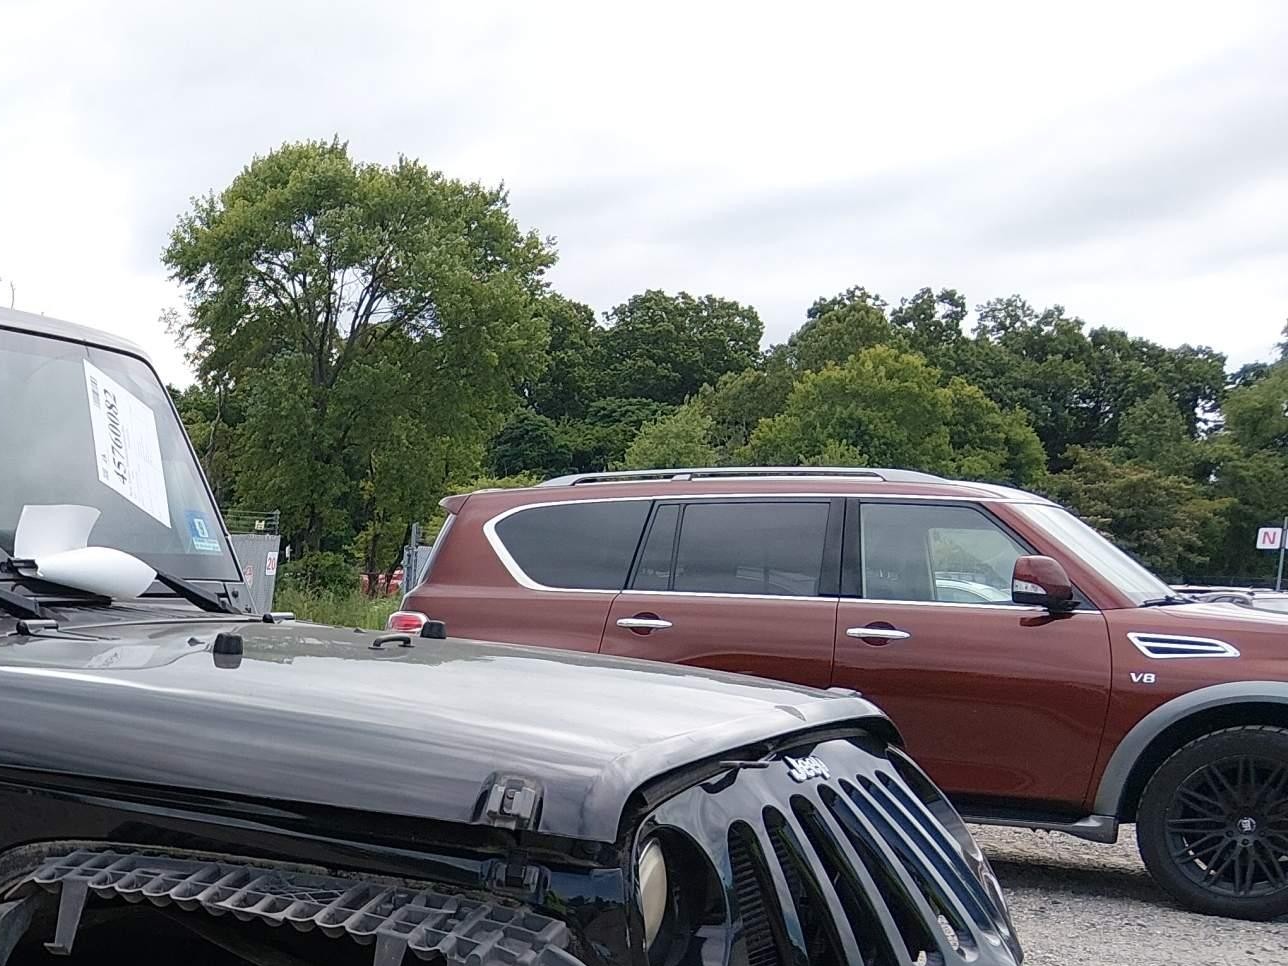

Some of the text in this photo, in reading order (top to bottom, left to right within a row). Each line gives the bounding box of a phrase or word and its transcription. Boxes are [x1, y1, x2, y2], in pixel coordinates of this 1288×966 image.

[103, 388, 127, 485] 45760082
[1262, 531, 1276, 545] N
[266, 557, 276, 571] 20
[1129, 672, 1156, 684] V8
[783, 755, 831, 782] Jeep
